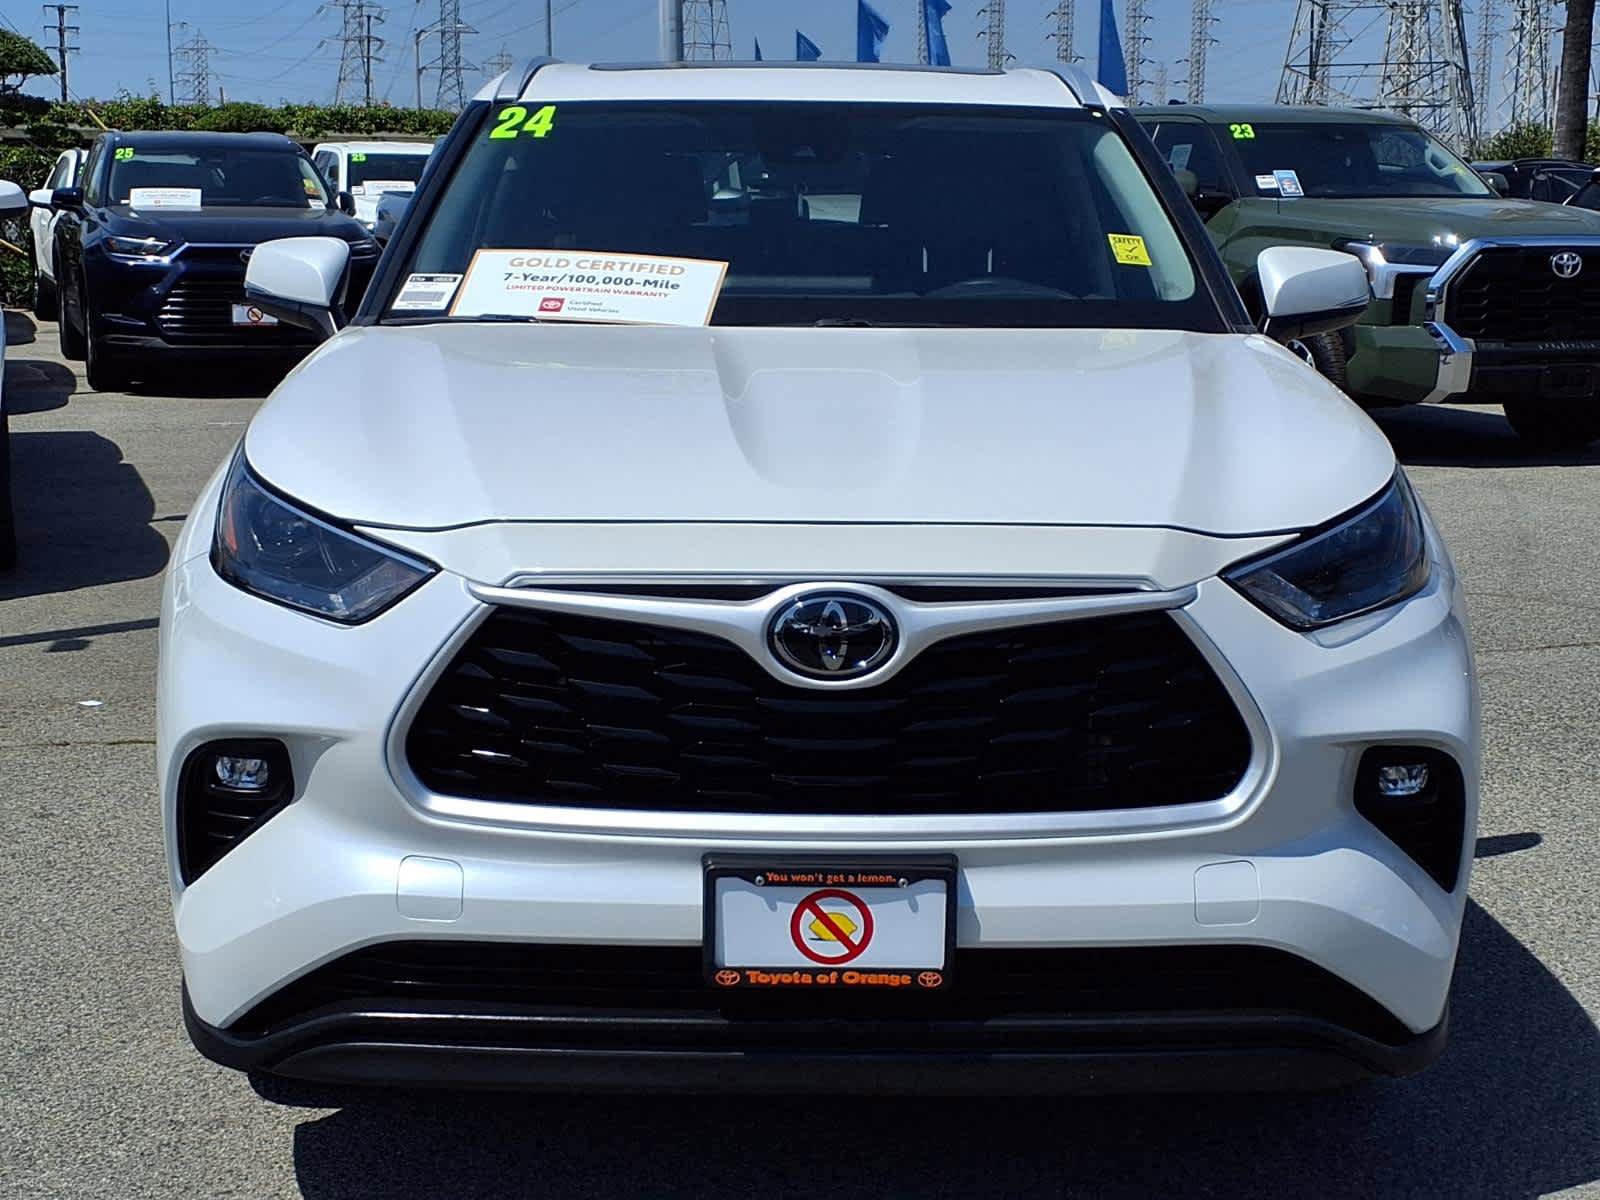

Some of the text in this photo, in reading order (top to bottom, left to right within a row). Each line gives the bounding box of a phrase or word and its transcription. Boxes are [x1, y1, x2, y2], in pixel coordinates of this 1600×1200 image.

[489, 106, 556, 138] 24
[1230, 124, 1255, 138] 23
[115, 147, 134, 159] 25
[509, 257, 685, 275] GOLD CERTIFIED
[503, 272, 680, 289] 7-Year/100,000-Mile
[545, 285, 611, 294] POWERTRAIN
[612, 289, 670, 298] WARRANTY
[766, 872, 788, 882] You
[791, 872, 824, 883] won't
[857, 874, 897, 883] lemon.
[746, 971, 912, 986] Toyota of Orange
